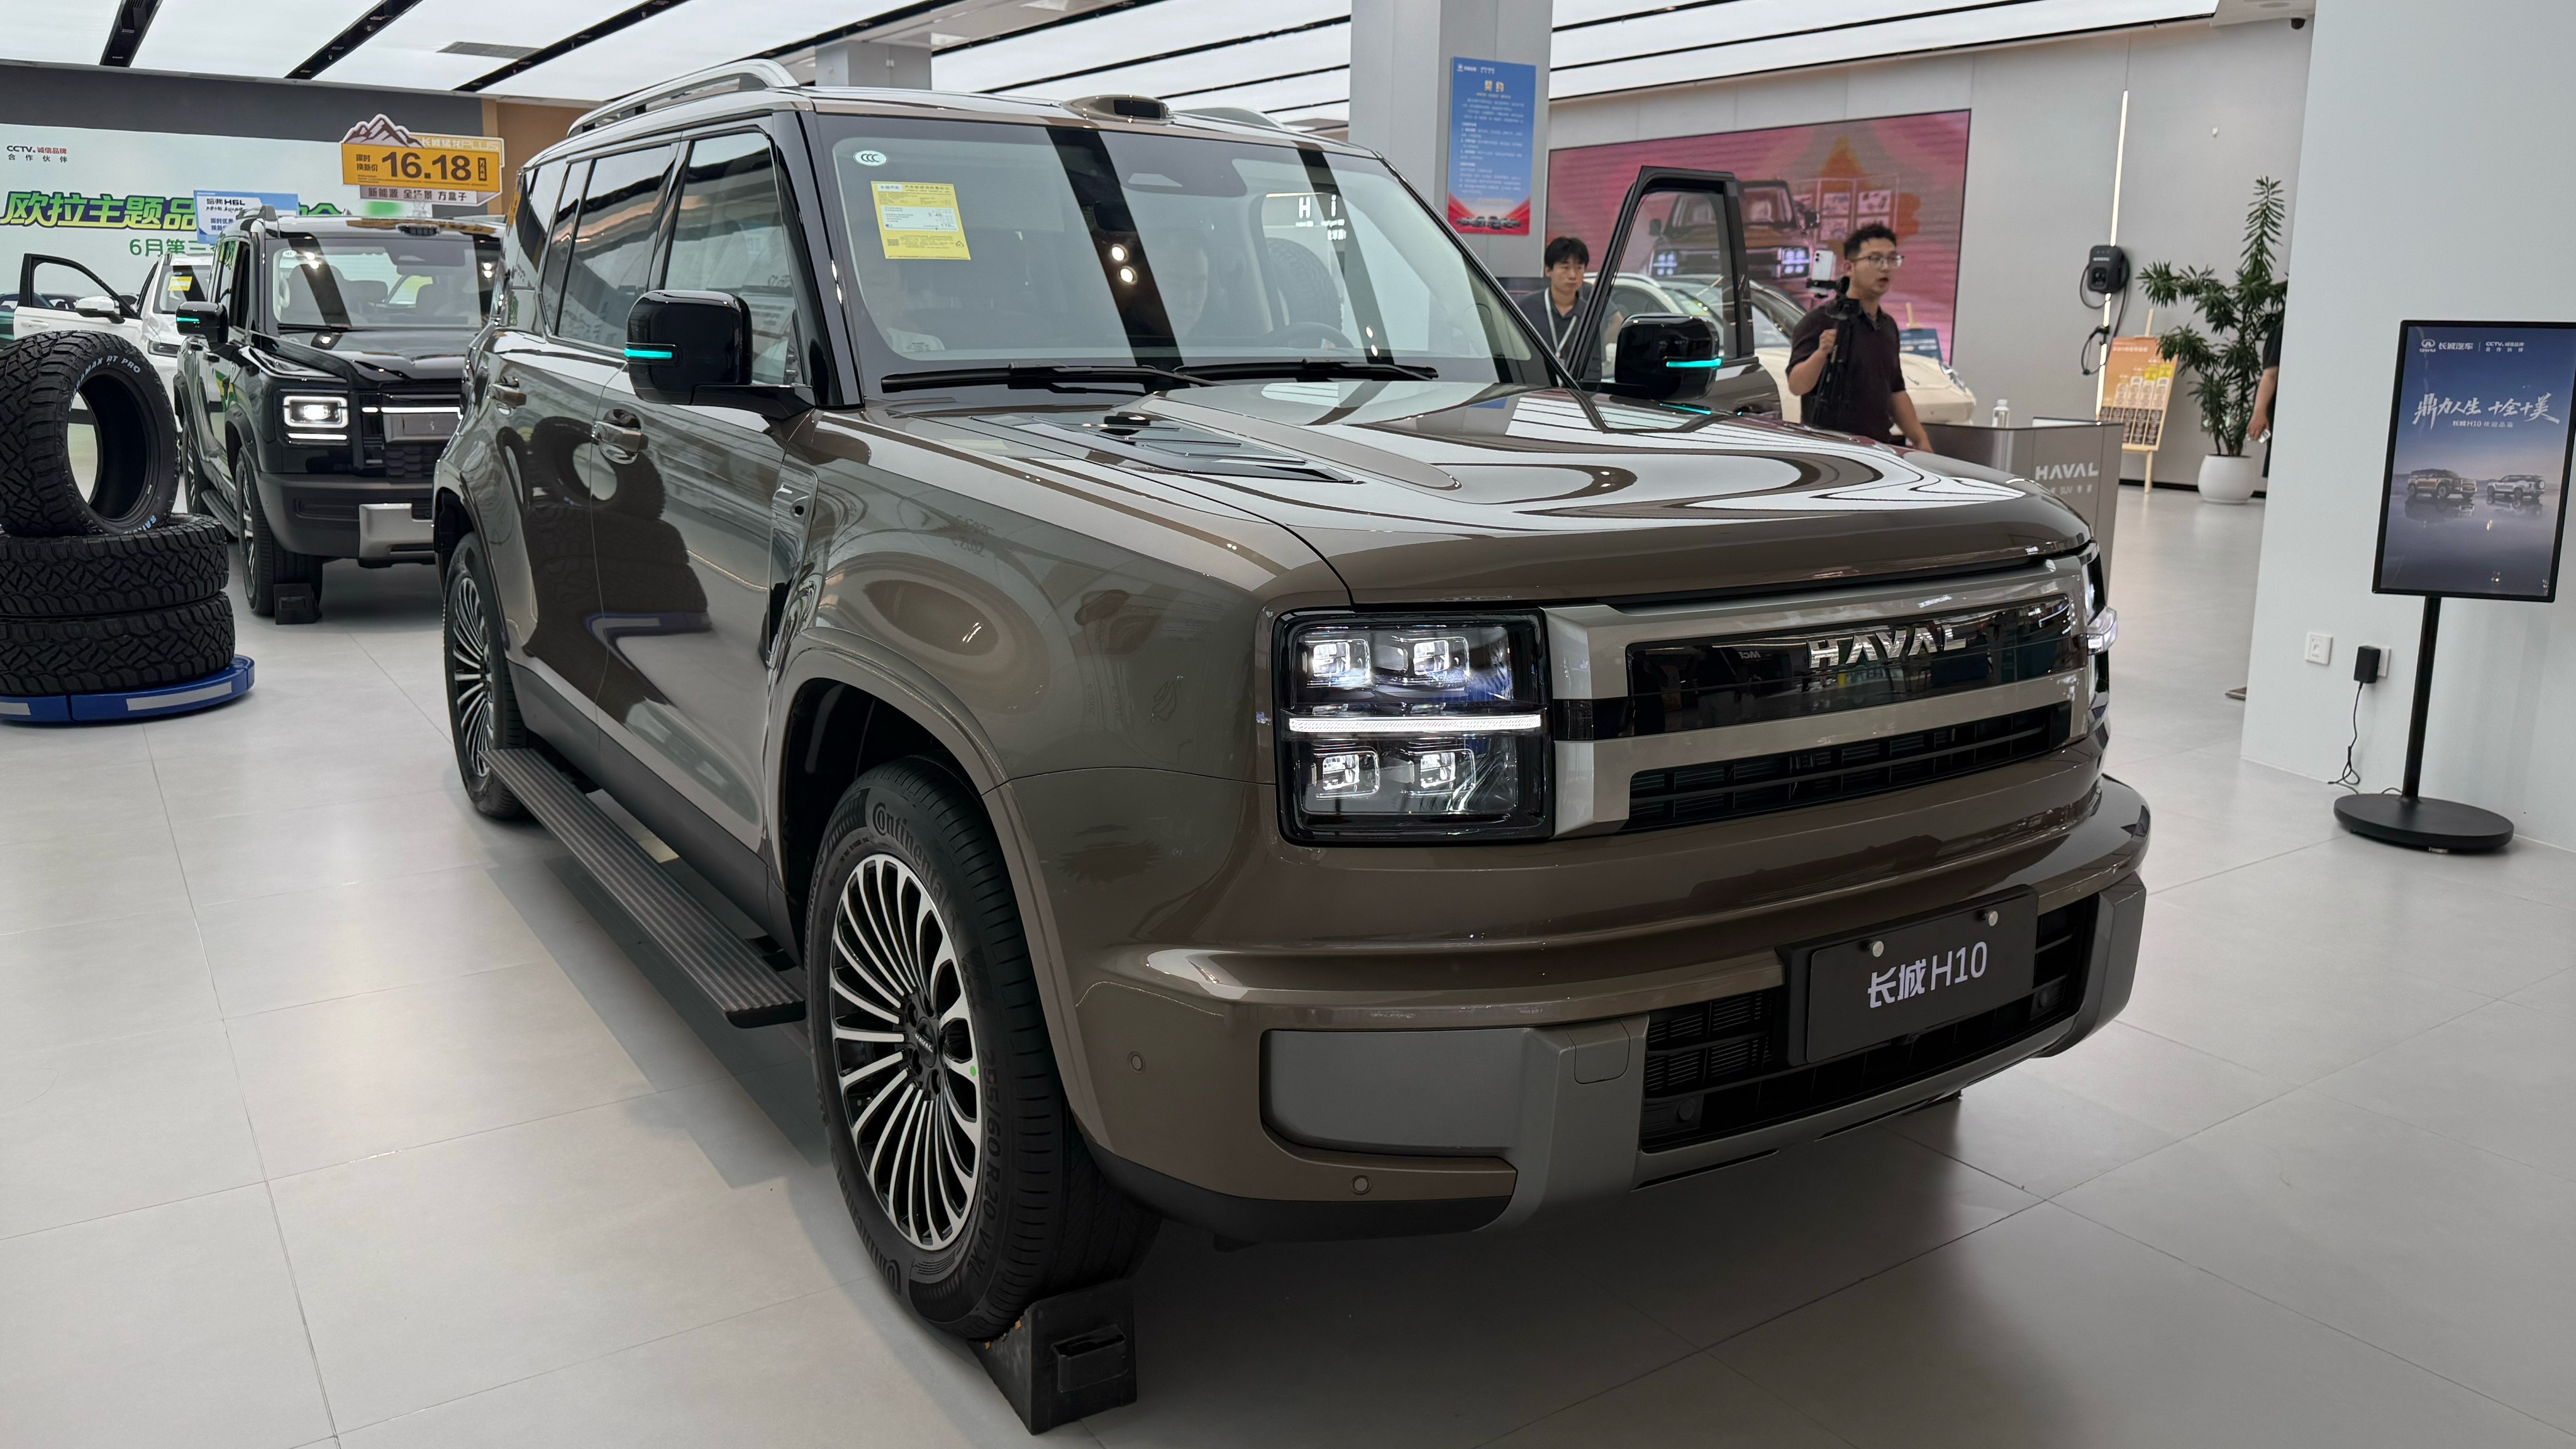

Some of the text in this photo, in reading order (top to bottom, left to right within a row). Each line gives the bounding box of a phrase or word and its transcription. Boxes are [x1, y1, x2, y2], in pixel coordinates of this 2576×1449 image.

[382, 152, 472, 181] 16.18
[2438, 342, 2473, 350] 长城汽车
[121, 358, 141, 373] PRO
[2035, 462, 2099, 480] HAVAL
[1807, 624, 1966, 669] HAVAL
